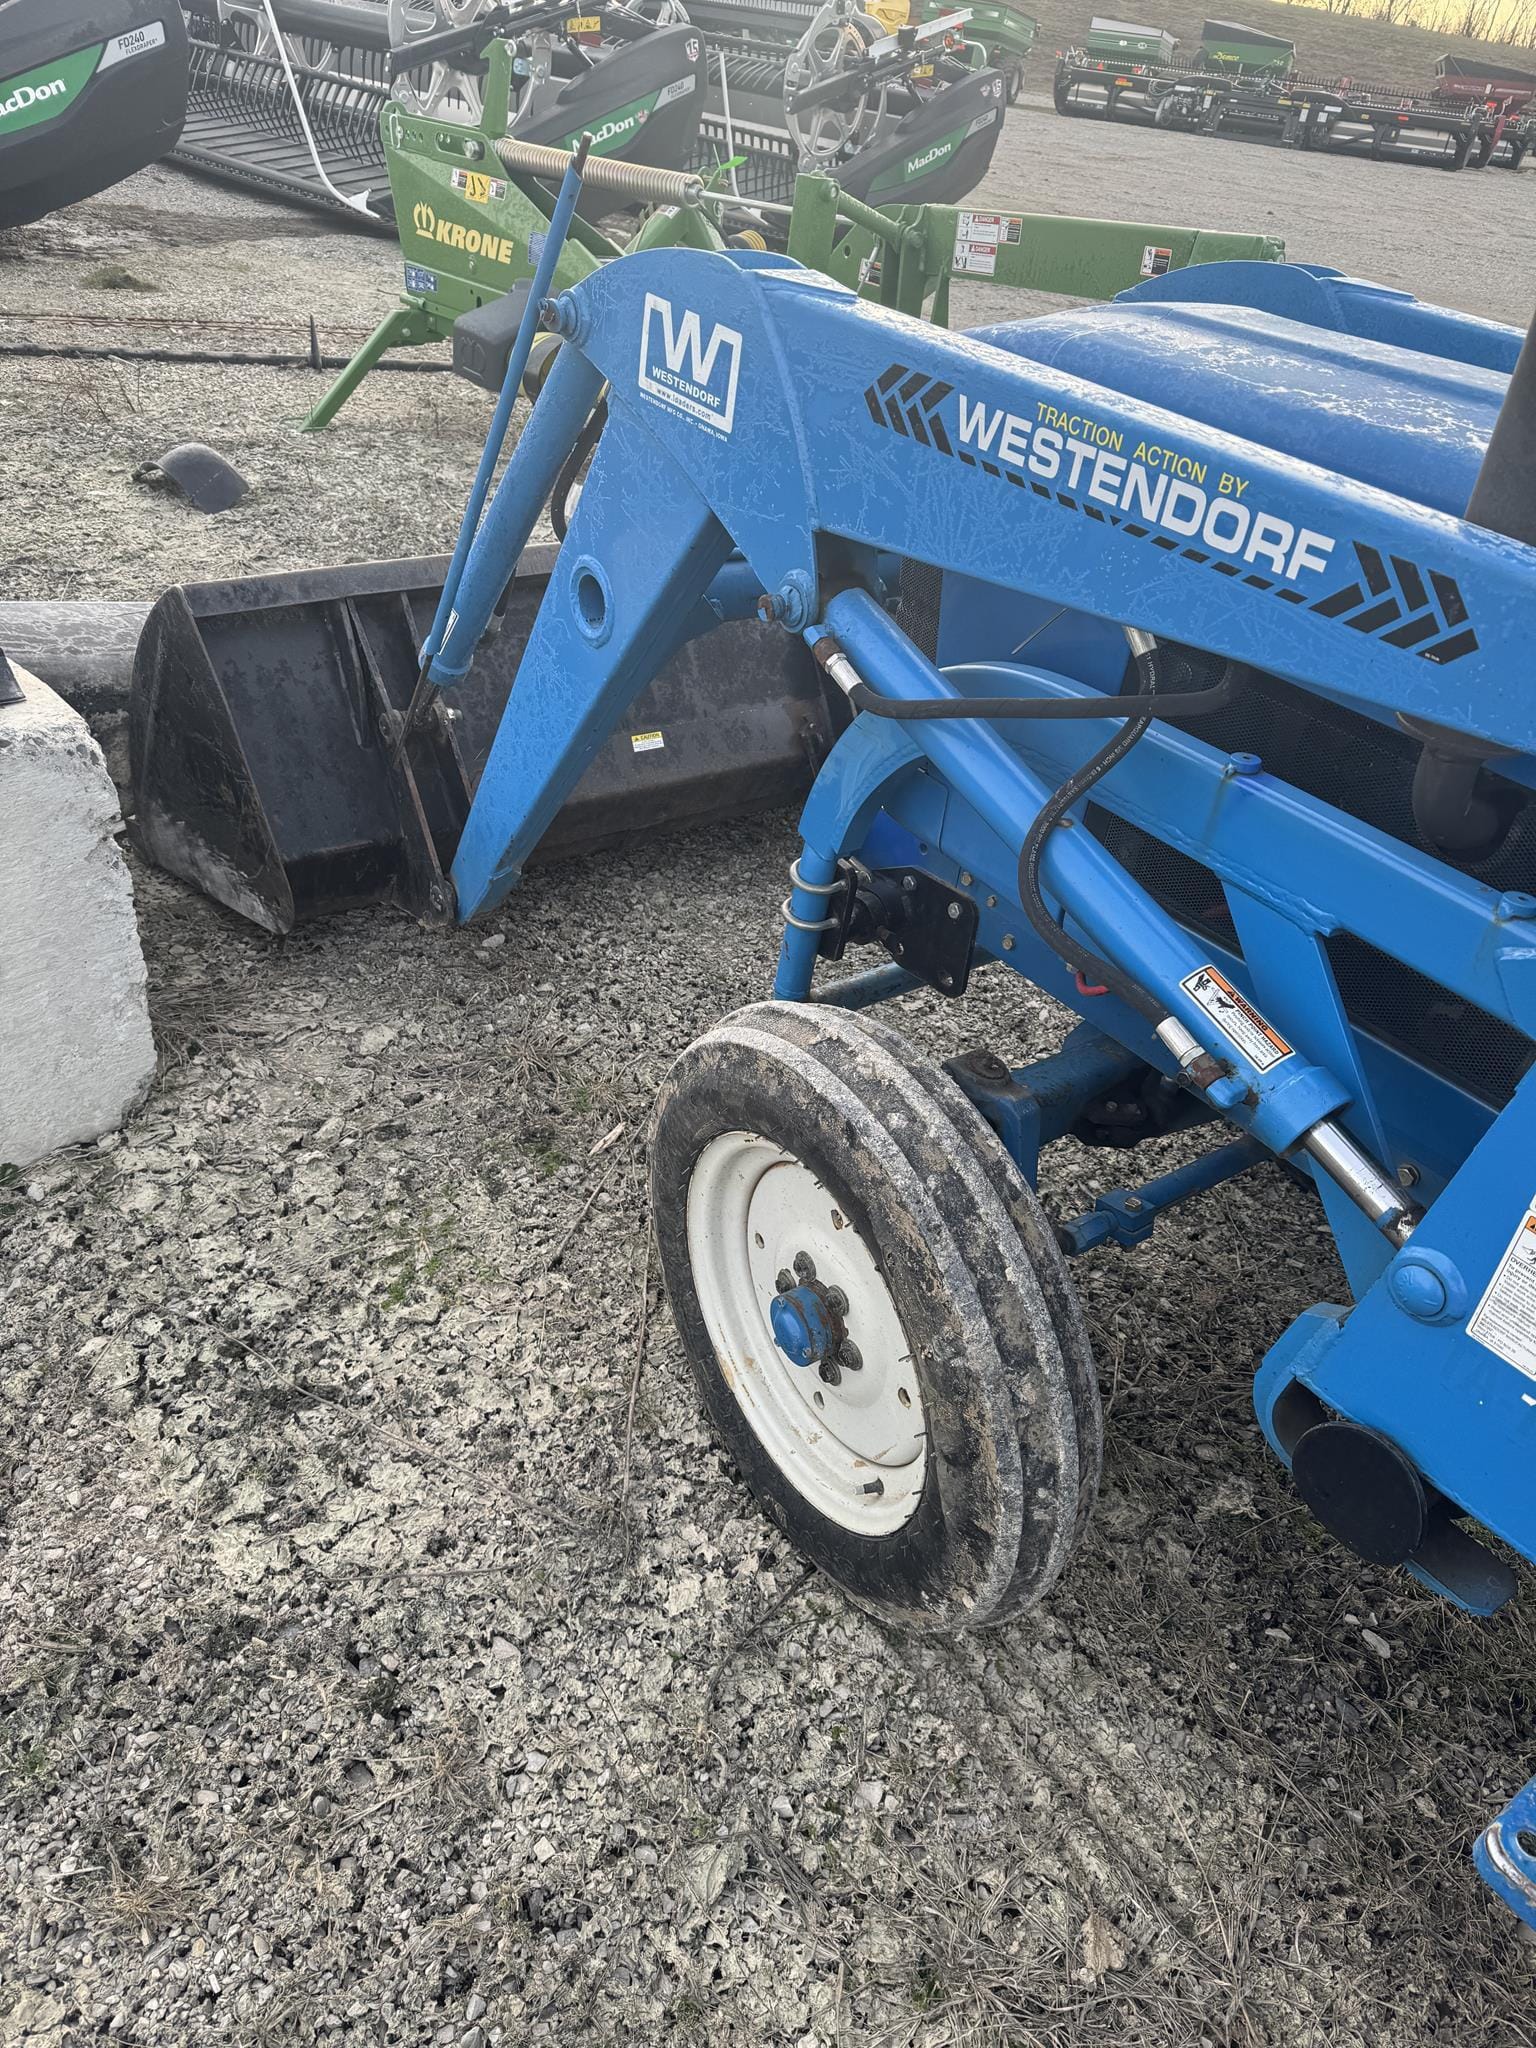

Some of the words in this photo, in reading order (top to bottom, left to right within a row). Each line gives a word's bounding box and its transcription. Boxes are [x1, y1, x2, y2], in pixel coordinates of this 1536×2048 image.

[117, 31, 145, 50] FD240
[907, 143, 952, 174] MacDon
[436, 219, 514, 265] KRONE
[652, 365, 721, 408] WESTENDORF
[657, 388, 712, 421] www.loaders.com
[1036, 402, 1123, 453] TRACTION
[1133, 442, 1208, 484] ACTION
[1219, 472, 1250, 500] BY
[958, 393, 1337, 581] WESTENDORF
[640, 733, 660, 741] CAUTION
[1235, 996, 1268, 1031] WARNING
[1235, 1009, 1249, 1024] PINCH
[1247, 1022, 1261, 1036] POINT
[1260, 1035, 1279, 1054] HAZARD
